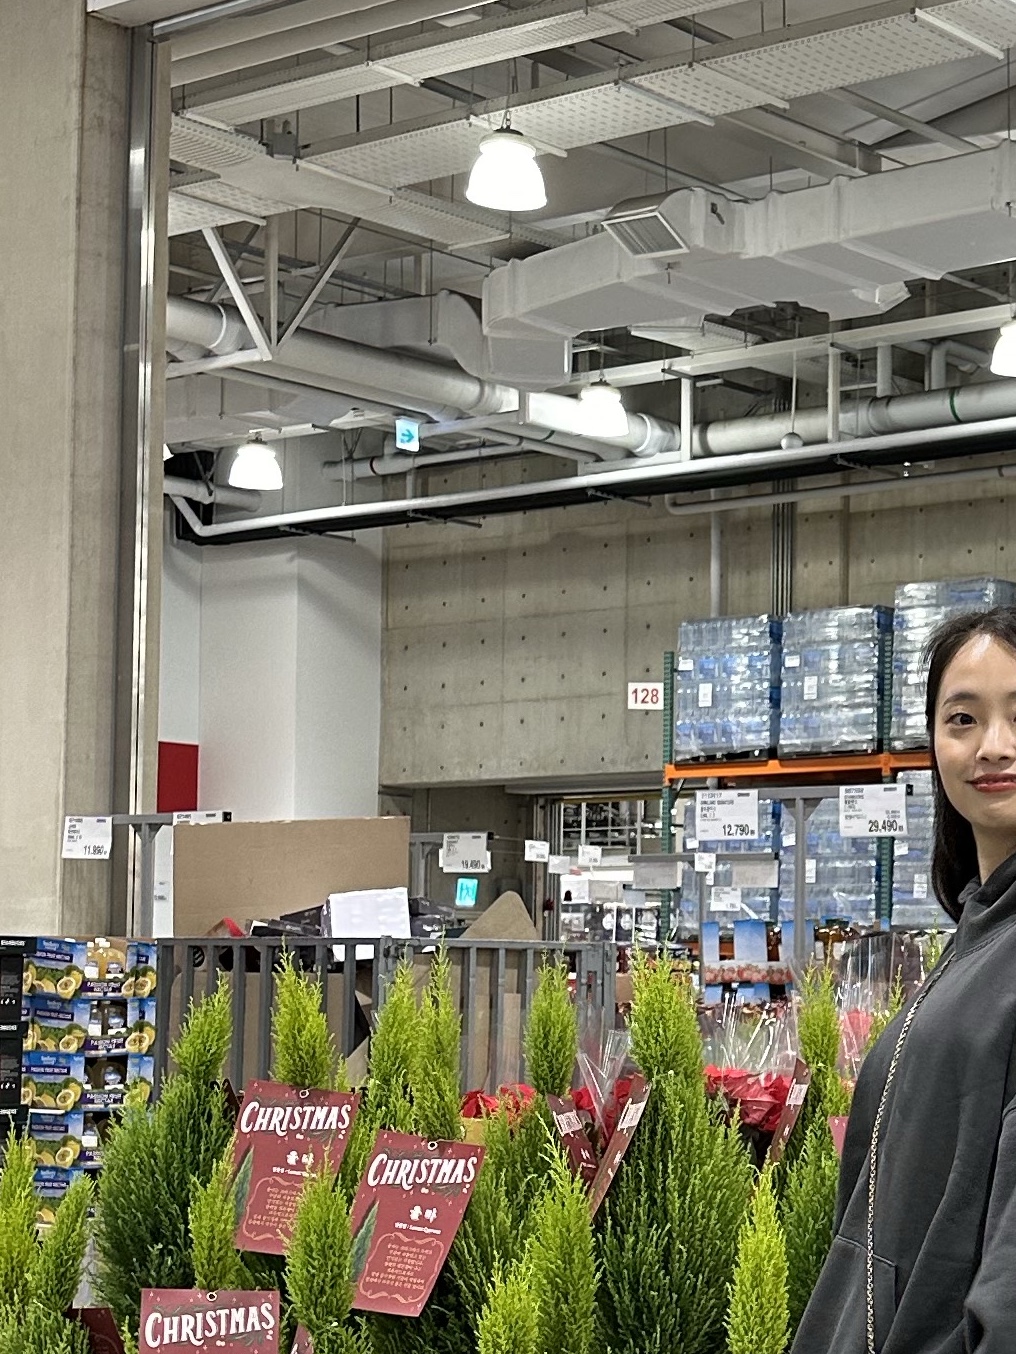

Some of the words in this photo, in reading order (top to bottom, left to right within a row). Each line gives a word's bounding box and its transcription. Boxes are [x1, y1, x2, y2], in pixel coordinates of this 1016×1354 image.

[631, 687, 659, 704] 128
[240, 1100, 352, 1137] CHRISTMAS
[367, 1153, 478, 1191] CHRISTMAS
[144, 1302, 276, 1349] CHRISTMAS
